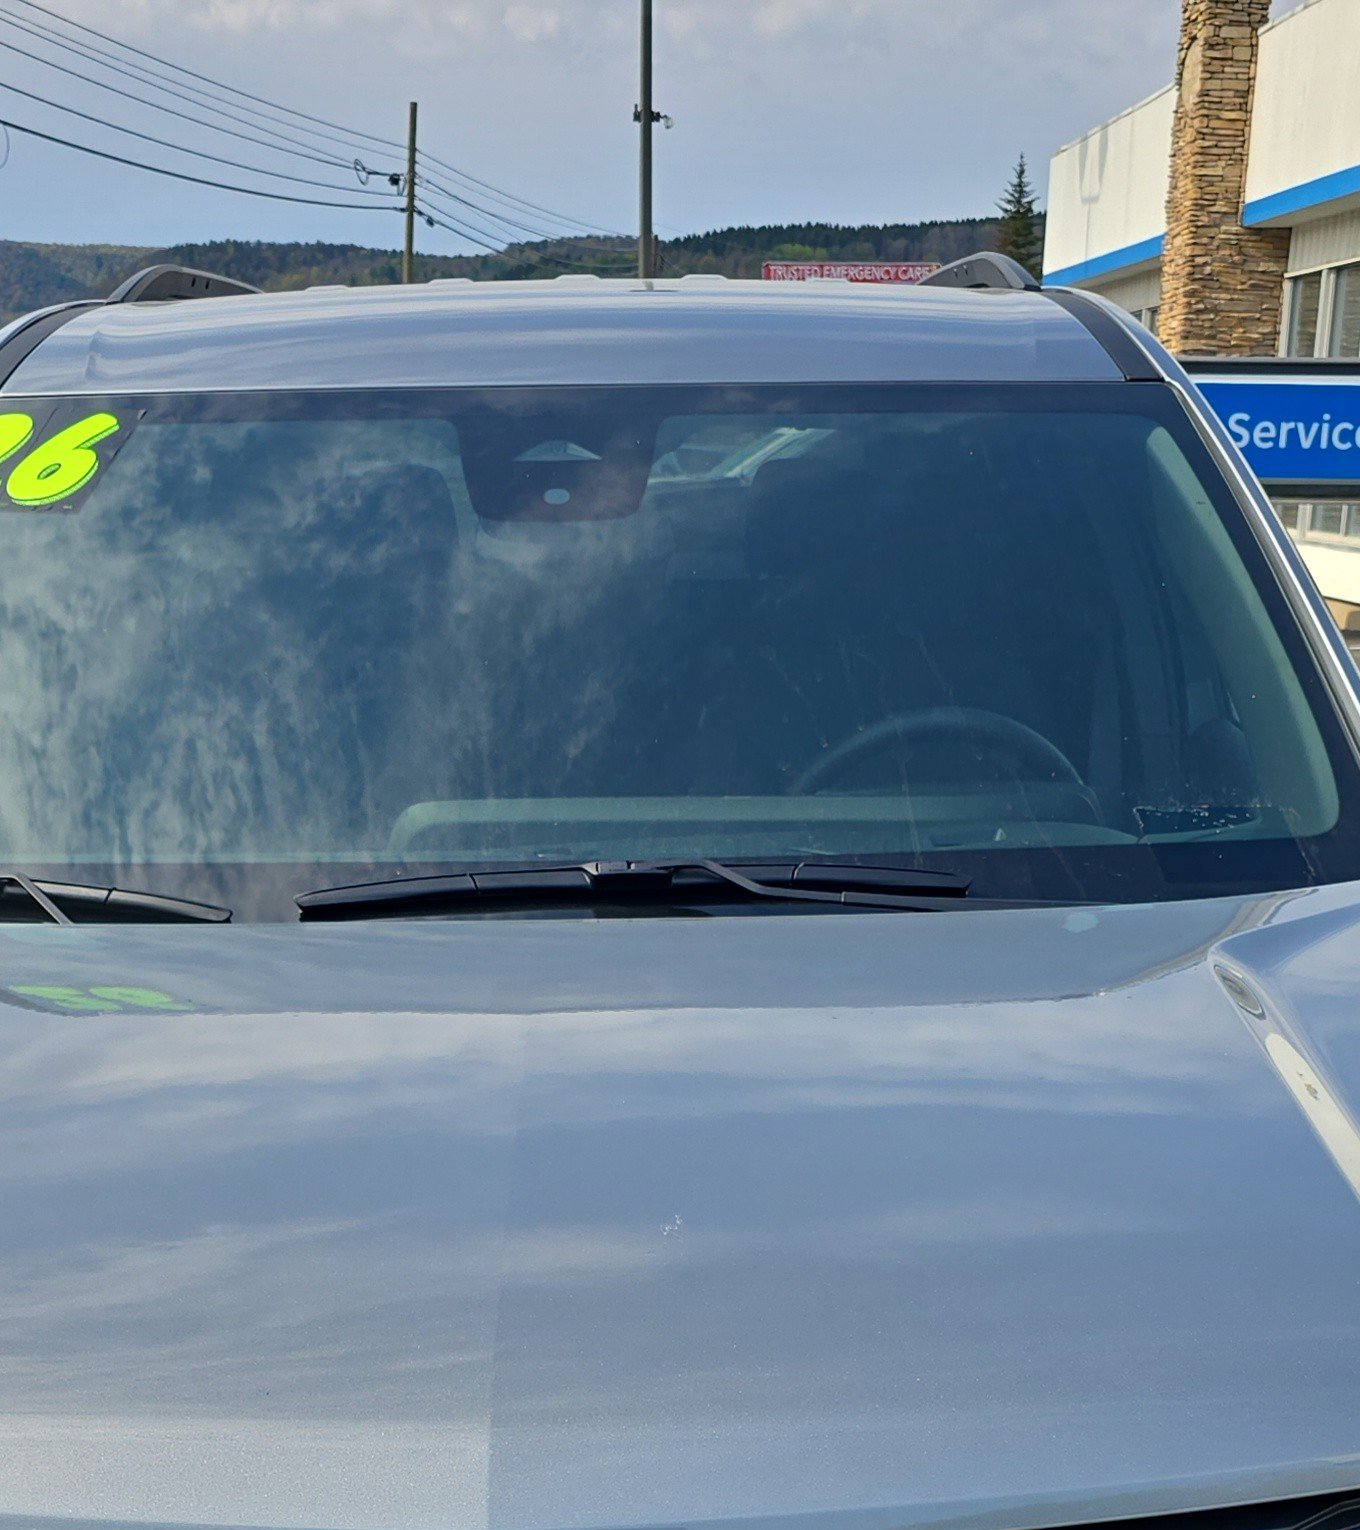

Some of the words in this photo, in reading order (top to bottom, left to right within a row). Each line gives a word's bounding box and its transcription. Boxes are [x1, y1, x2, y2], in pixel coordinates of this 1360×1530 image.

[768, 265, 821, 281] TRUSTED
[822, 265, 897, 281] EMERGENCY
[897, 265, 929, 281] CARE
